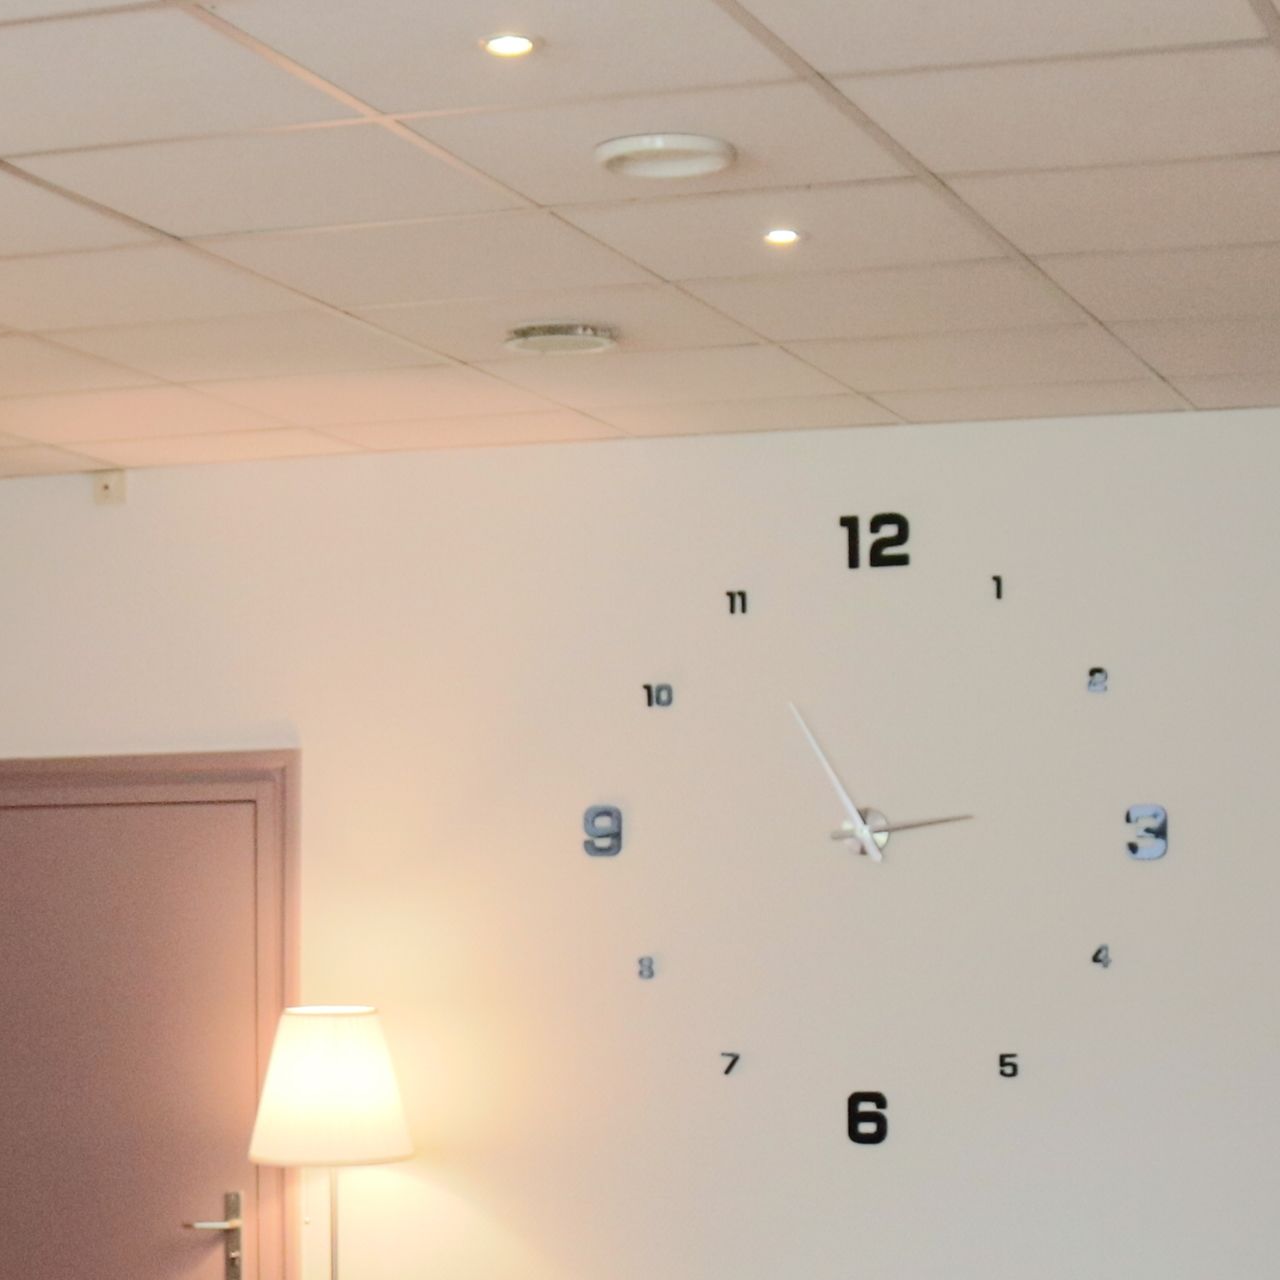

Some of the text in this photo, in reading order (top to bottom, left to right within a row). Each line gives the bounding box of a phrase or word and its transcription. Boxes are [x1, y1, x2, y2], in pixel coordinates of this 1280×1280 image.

[838, 512, 911, 570] 12
[992, 575, 1003, 601] 1
[724, 590, 748, 616] 11
[1087, 667, 1109, 693] 2
[642, 683, 674, 709] 10
[583, 804, 624, 858] 9
[1124, 806, 1168, 861] 3
[637, 956, 656, 980] 8
[1090, 944, 1112, 970] 4
[721, 1052, 741, 1076] 7
[998, 1053, 1020, 1079] 5
[846, 1091, 890, 1147] 6
